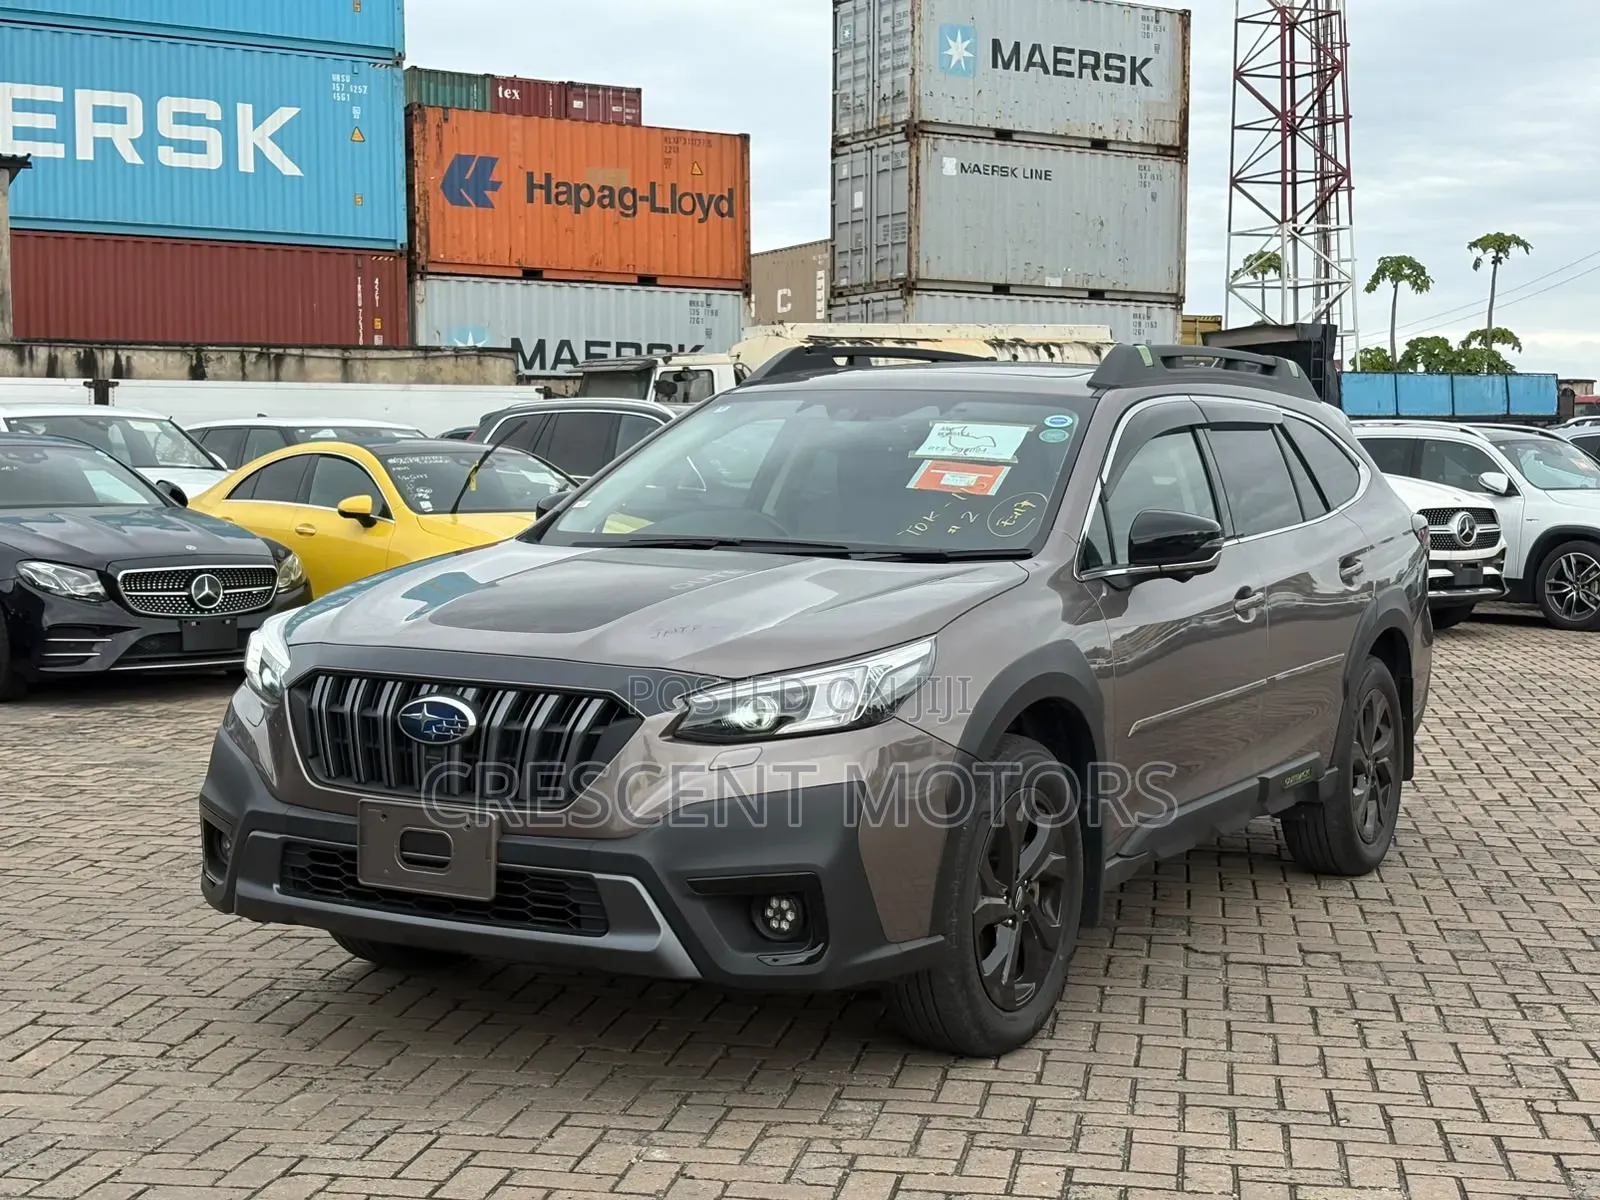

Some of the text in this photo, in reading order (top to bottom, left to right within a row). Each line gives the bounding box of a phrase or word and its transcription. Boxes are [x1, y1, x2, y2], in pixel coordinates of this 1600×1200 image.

[991, 38, 1153, 87] MAERSK
[498, 84, 520, 100] tex
[960, 162, 1052, 181] MAERSK LINE
[526, 171, 735, 223] Hapag-Lloyd
[511, 338, 705, 371] MAE
